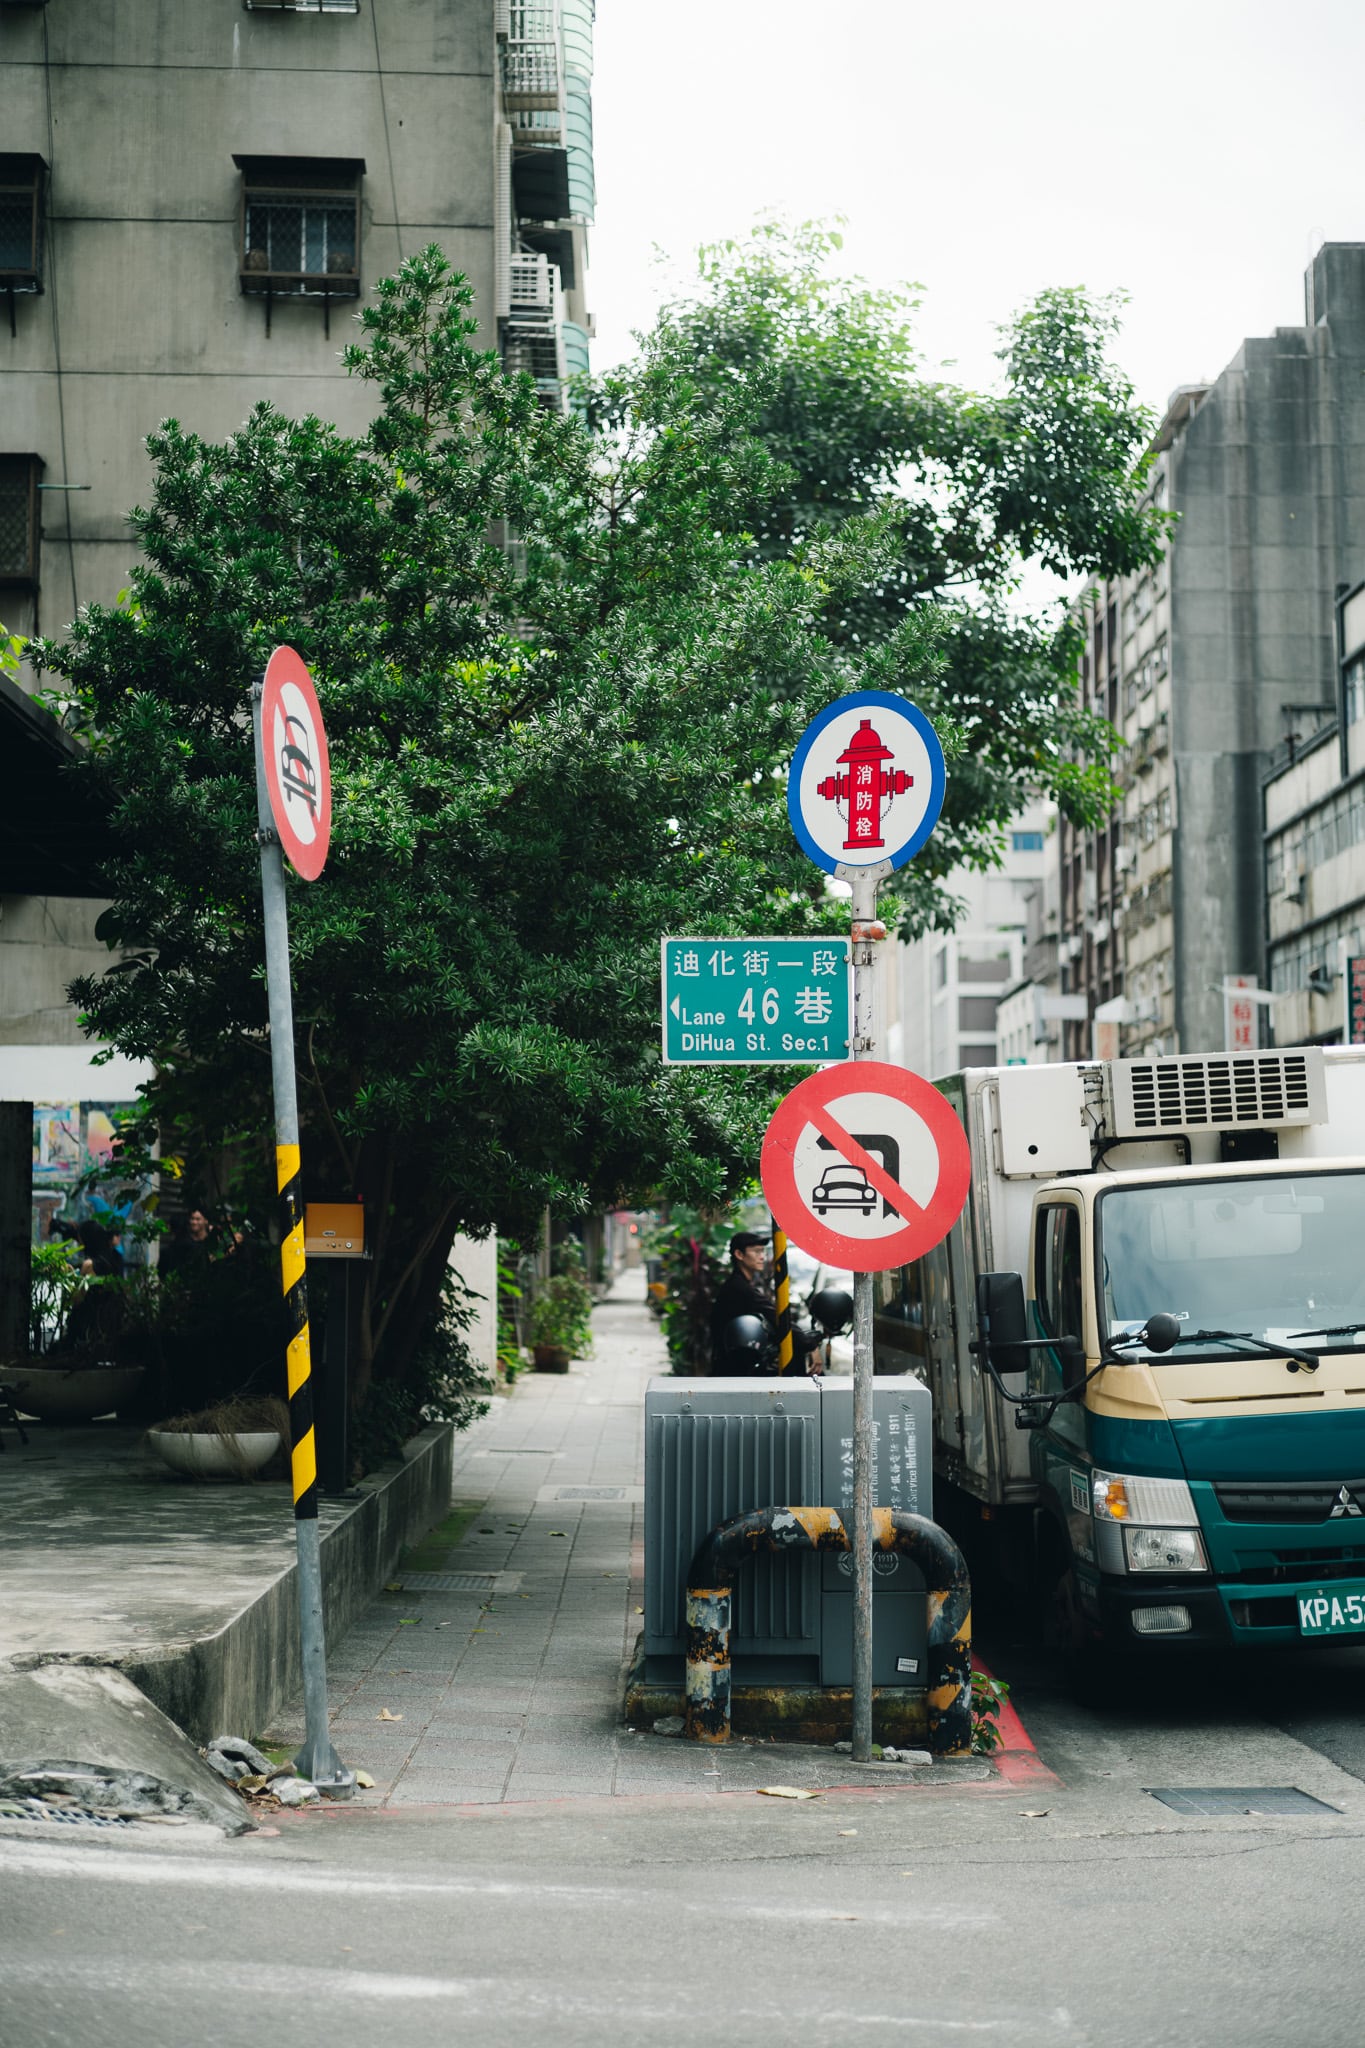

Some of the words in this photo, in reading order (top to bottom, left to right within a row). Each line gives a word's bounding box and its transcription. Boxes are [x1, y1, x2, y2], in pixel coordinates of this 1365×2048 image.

[855, 765, 873, 837] 消防栓
[673, 949, 838, 977] 迪化街一段
[682, 1007, 725, 1025] Lane
[737, 987, 780, 1026] 46
[794, 986, 833, 1024] 巷
[681, 1033, 735, 1052] DiHua
[746, 1033, 771, 1051] St.
[781, 1033, 829, 1051] Sec.1
[889, 1414, 900, 1434] 1911
[907, 1470, 918, 1502] Service
[1299, 1595, 1365, 1628] KPA-5
